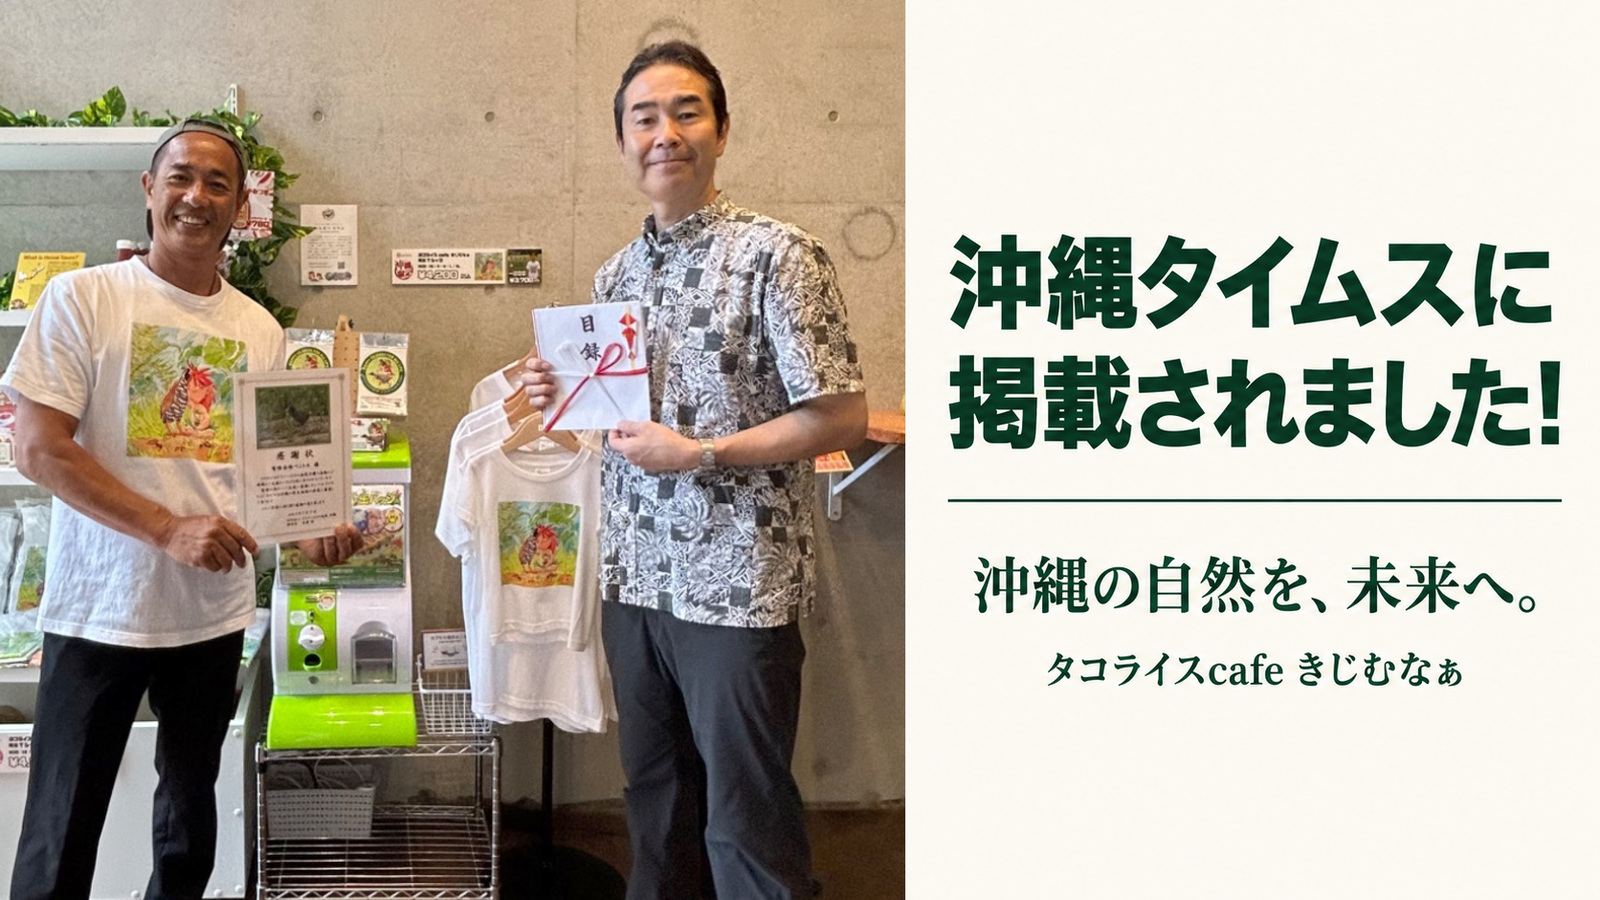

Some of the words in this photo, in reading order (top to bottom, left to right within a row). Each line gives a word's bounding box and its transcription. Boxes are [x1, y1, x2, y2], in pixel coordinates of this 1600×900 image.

[579, 314, 602, 362] 目録
[276, 448, 314, 461] 感謝状
